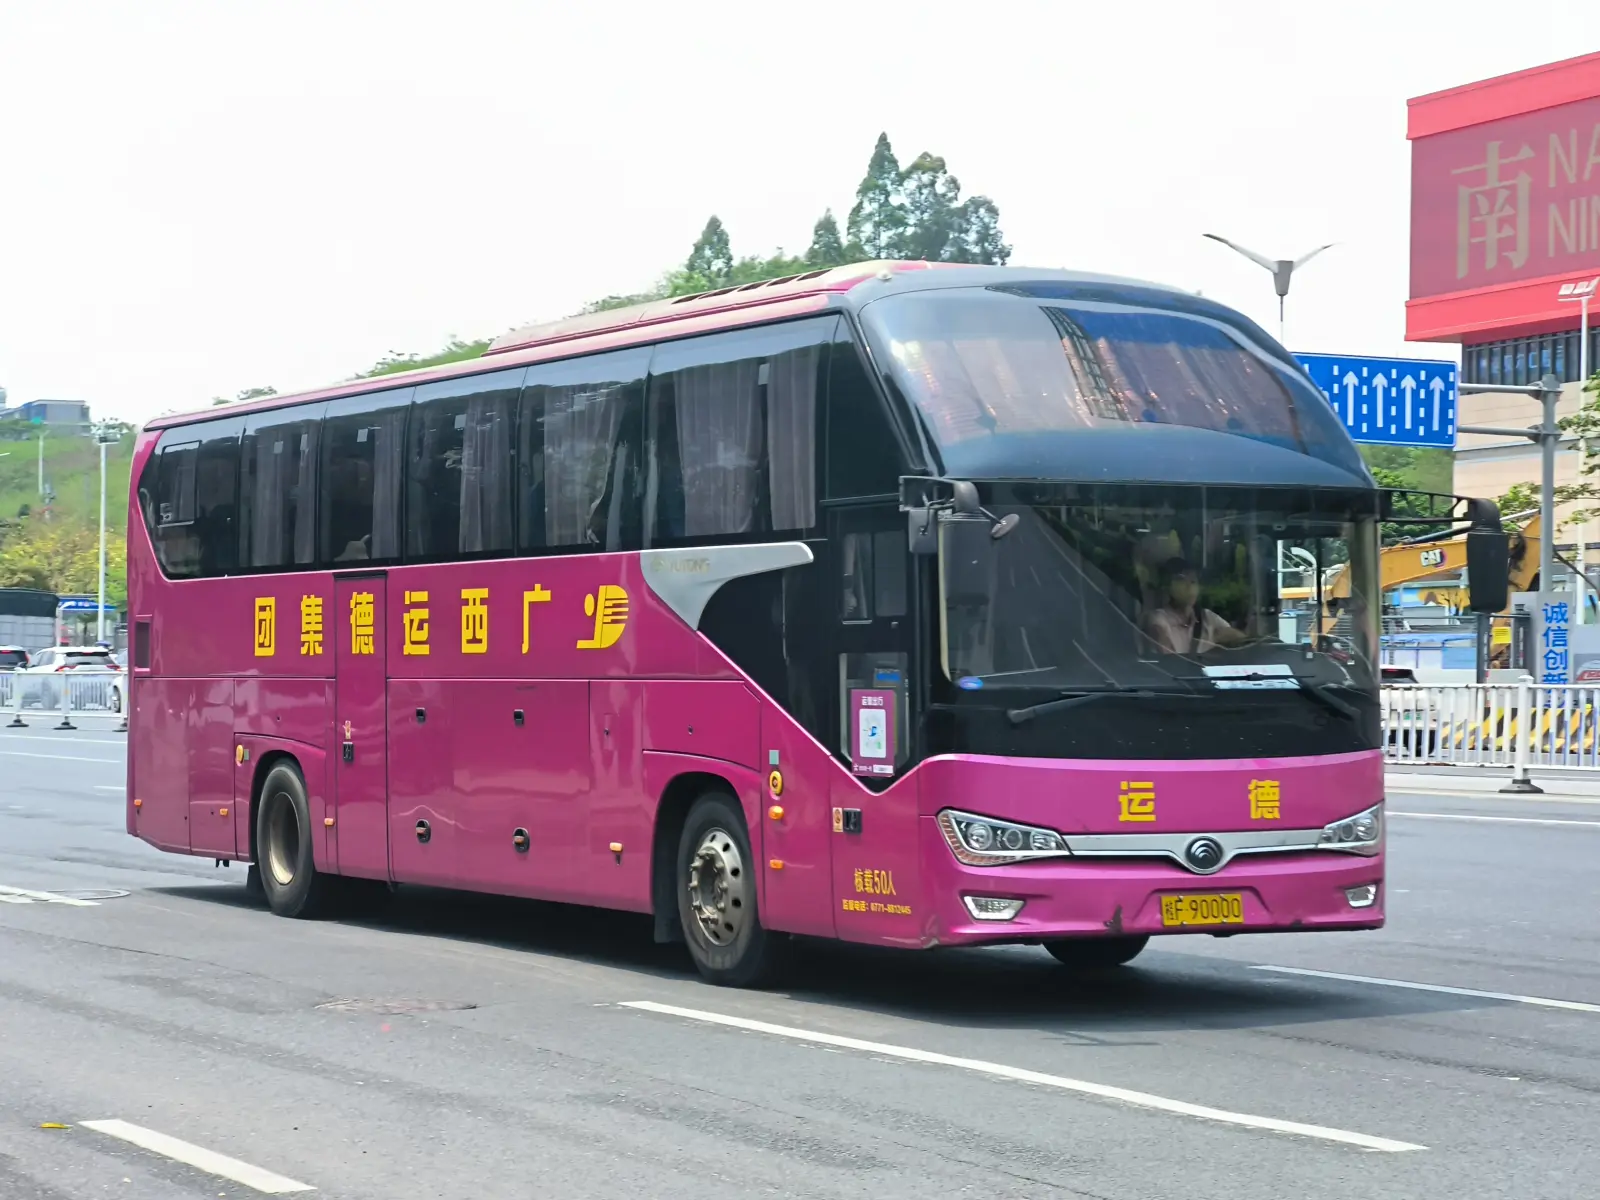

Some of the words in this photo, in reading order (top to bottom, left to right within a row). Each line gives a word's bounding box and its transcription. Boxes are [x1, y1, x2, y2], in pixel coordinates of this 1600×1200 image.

[1451, 141, 1536, 280] 南
[1420, 550, 1443, 567] CAT
[1542, 602, 1569, 707] 诚信创新
[854, 868, 896, 896] 核载50人
